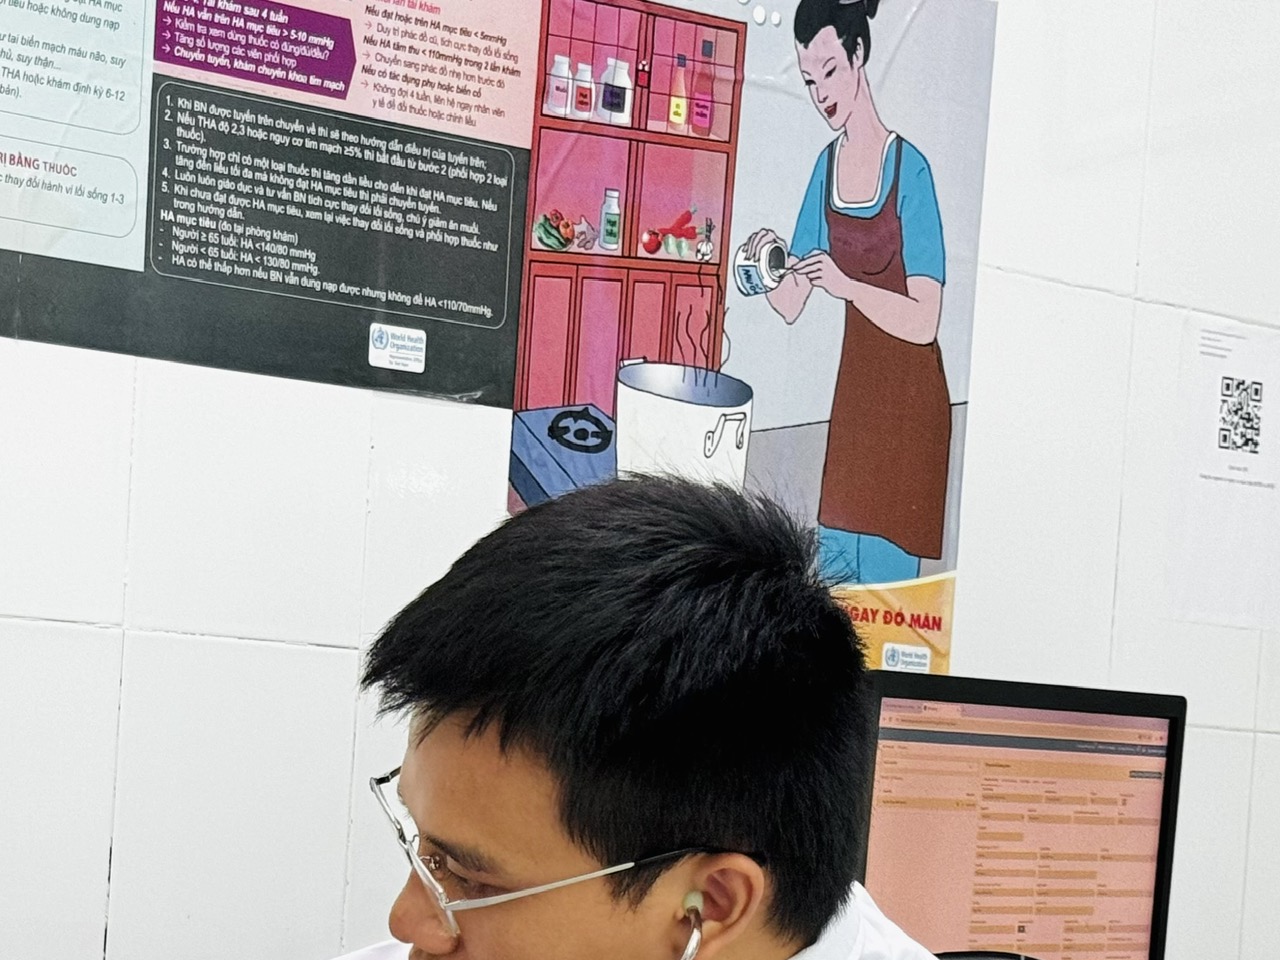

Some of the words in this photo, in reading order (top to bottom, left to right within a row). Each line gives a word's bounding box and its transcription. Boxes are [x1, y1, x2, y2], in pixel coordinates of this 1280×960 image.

[7, 33, 18, 43] tai
[110, 56, 126, 68] suy
[16, 53, 32, 66] suy
[1, 65, 20, 80] THA
[105, 87, 125, 101] 6-12
[4, 173, 24, 188] thay
[65, 185, 73, 194] vi
[111, 192, 124, 204] 1-3
[846, 606, 879, 624] GAY
